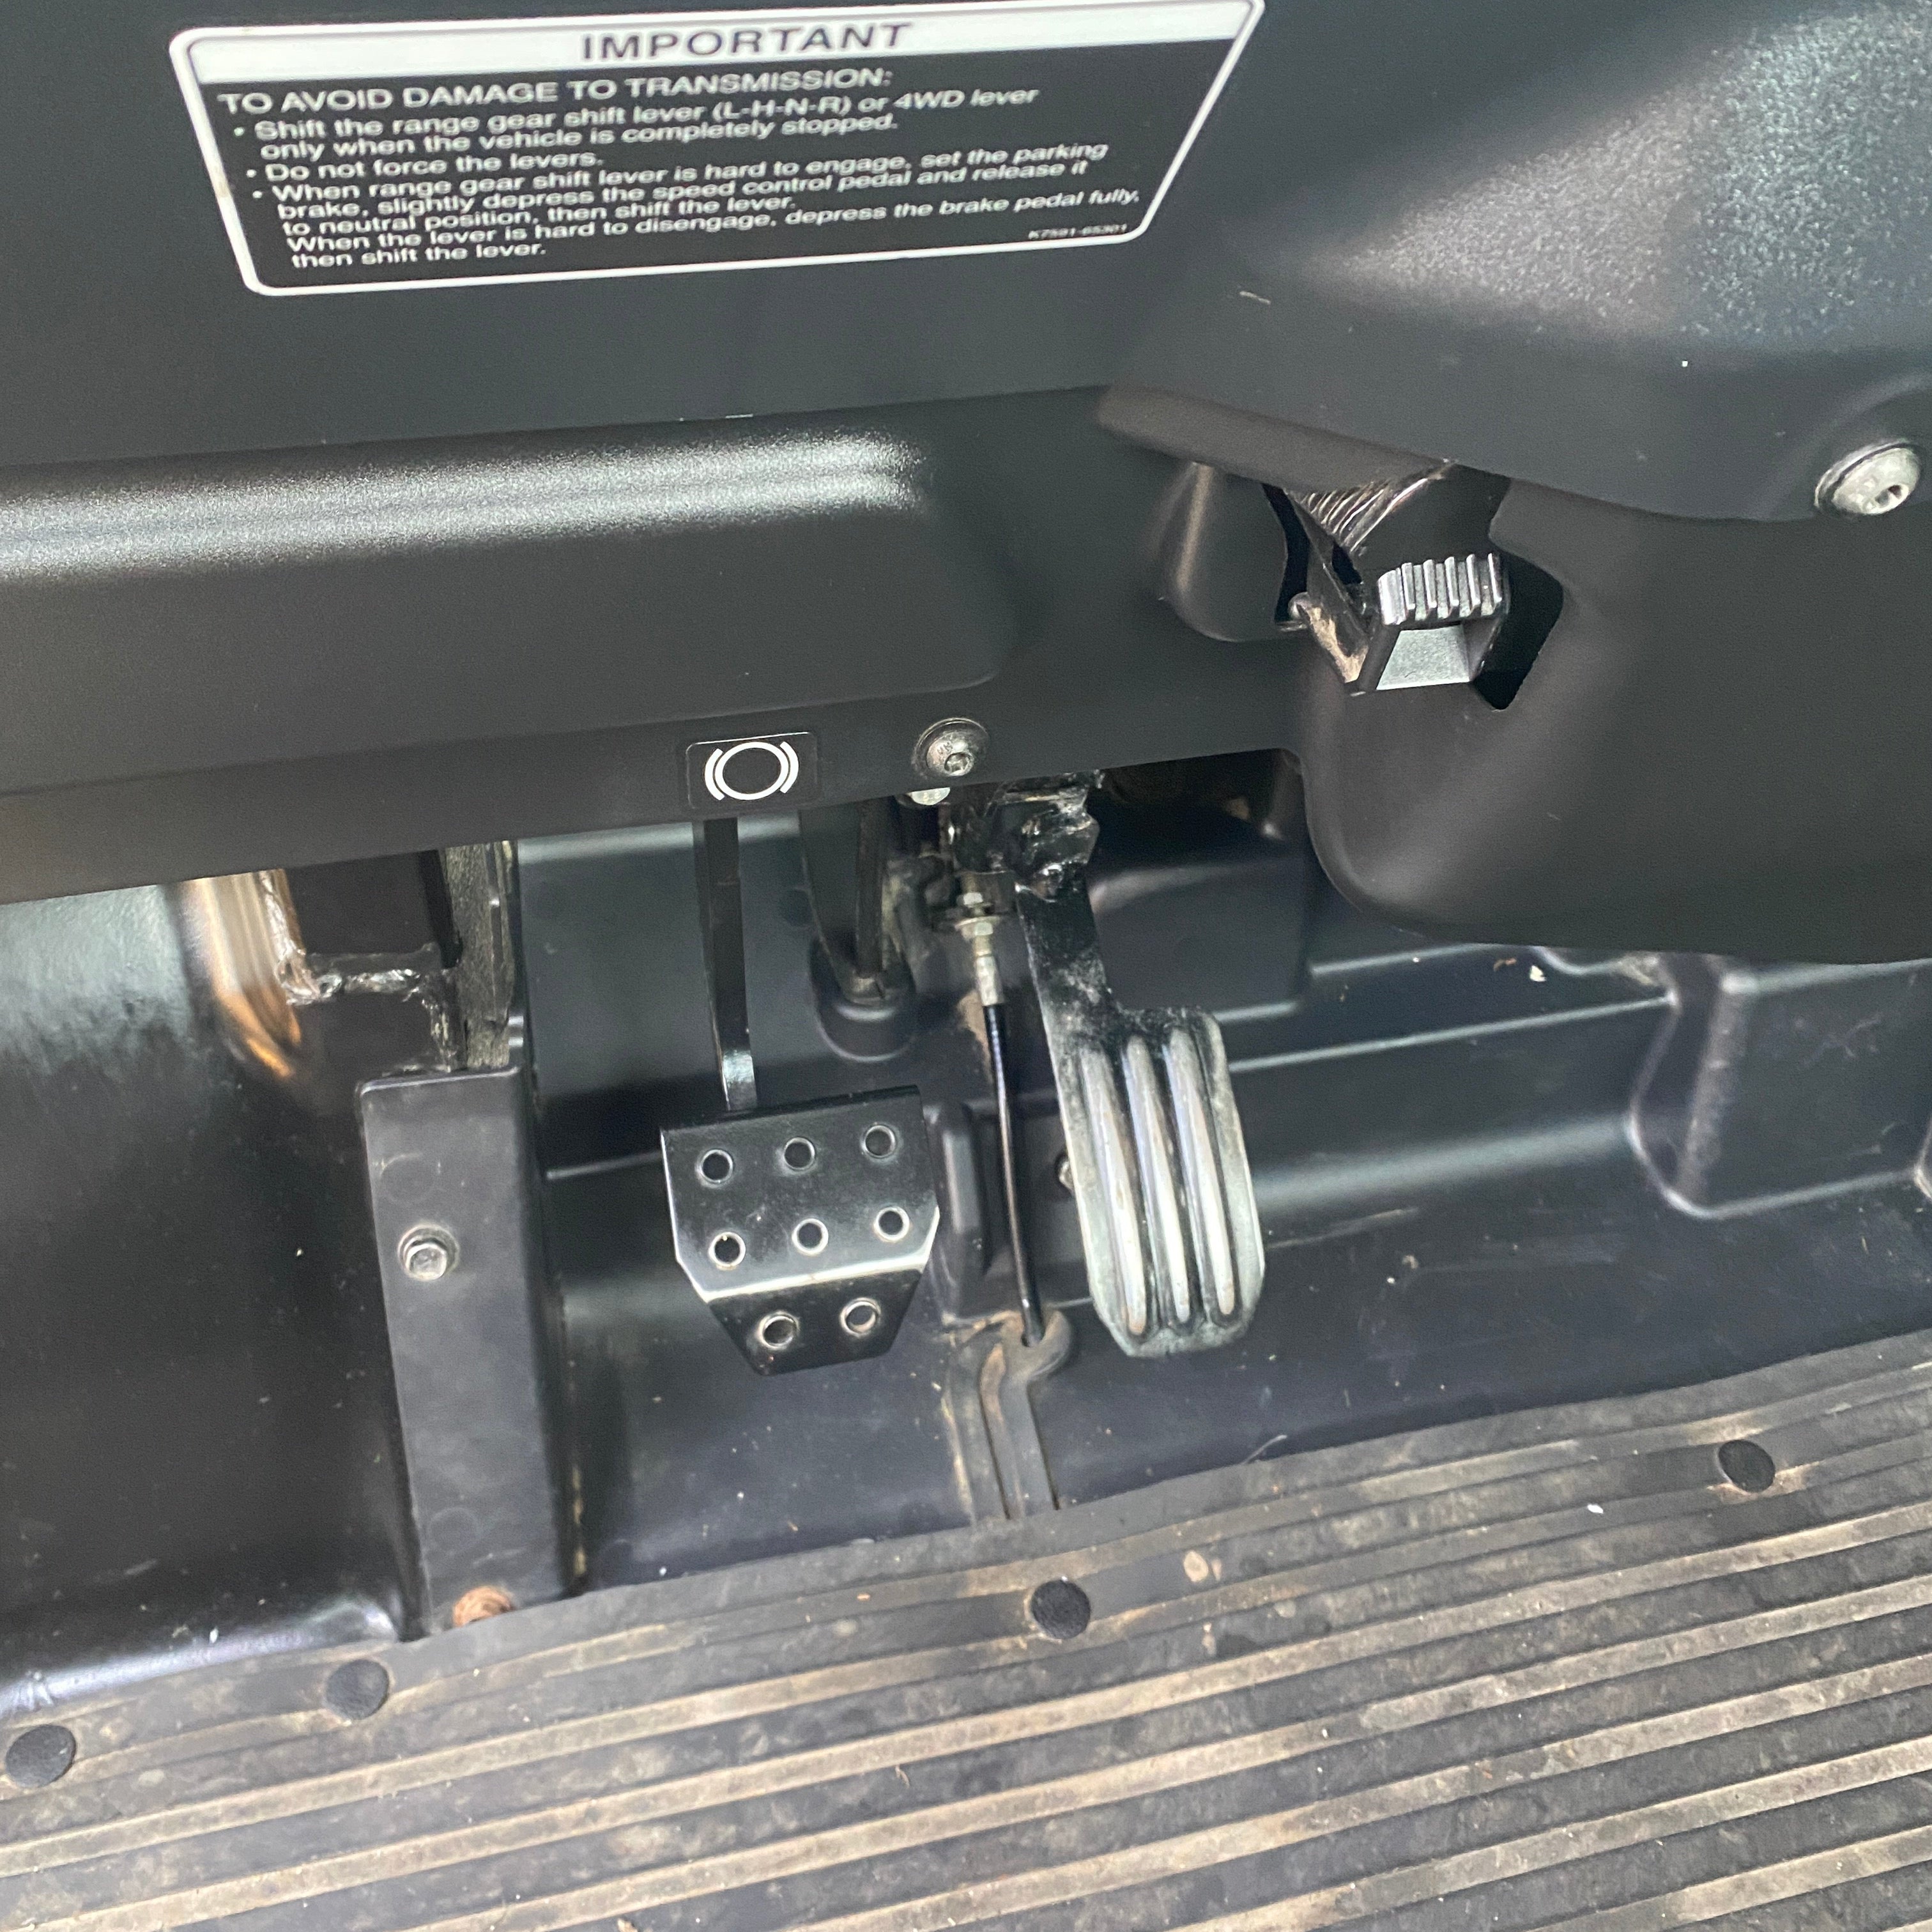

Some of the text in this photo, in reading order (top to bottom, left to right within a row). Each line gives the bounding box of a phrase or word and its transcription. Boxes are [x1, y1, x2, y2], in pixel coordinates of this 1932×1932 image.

[583, 22, 912, 59] IMPORTANT
[217, 67, 894, 114] TO AVOID DAMAGE TO TRANSMISSION:
[255, 88, 1040, 141] Shift the range gear shift lever (L-H-N-R) or 4WD lever
[261, 113, 898, 162] only when the vehicle is completely stopped.
[265, 151, 604, 181] Do not force the levers.
[272, 183, 360, 203] When
[369, 180, 452, 198] range
[459, 176, 525, 197] gear
[533, 171, 591, 190] shift
[599, 168, 669, 185] lever
[673, 165, 698, 182] is
[705, 161, 766, 181] hard
[773, 161, 800, 176] to
[921, 150, 962, 169] set
[967, 148, 1009, 165] the
[1012, 142, 1108, 165] parking
[378, 197, 475, 217] slightly
[482, 190, 594, 210] depress
[602, 186, 645, 203] the
[652, 180, 735, 201] speed
[742, 174, 832, 195] control
[838, 170, 912, 192] pedal
[916, 167, 967, 185] and
[972, 163, 1065, 181] release
[1071, 160, 1088, 175] it
[282, 220, 310, 236] to
[319, 214, 416, 234] neutral
[548, 206, 608, 222] then
[615, 200, 670, 218] shift
[678, 199, 720, 215] the
[727, 195, 795, 212] lever.
[287, 236, 371, 252] When
[378, 233, 422, 247] the
[430, 229, 497, 245] lever
[505, 226, 527, 241] is
[535, 221, 595, 240] hard
[603, 220, 628, 236] to
[785, 206, 887, 226] depress
[894, 202, 933, 218] the
[939, 197, 1009, 215] brake
[1013, 192, 1084, 213] pedal
[292, 242, 546, 269] then shift the lever.
